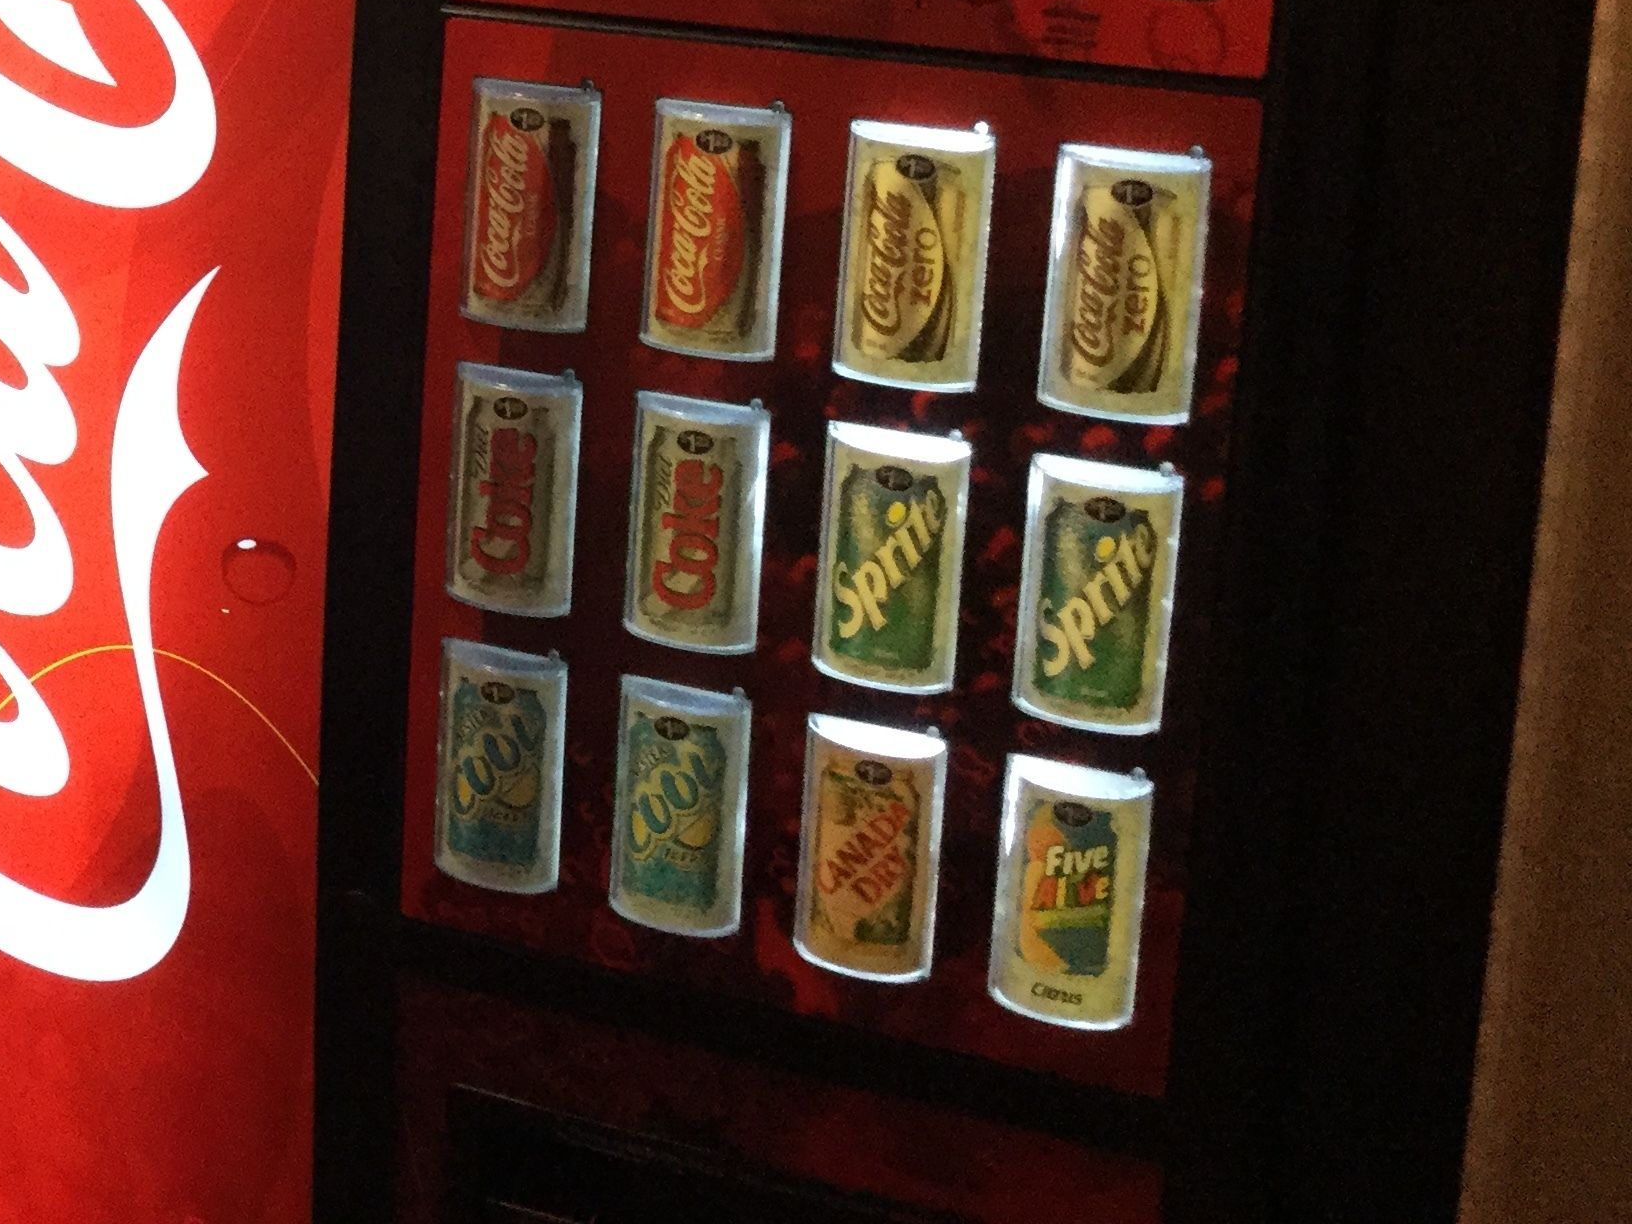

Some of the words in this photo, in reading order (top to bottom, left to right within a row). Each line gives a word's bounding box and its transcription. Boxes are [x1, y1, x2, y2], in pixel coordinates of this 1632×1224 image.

[480, 127, 530, 288] Coca-Cola
[665, 152, 716, 314] Coca-Cola
[862, 182, 914, 337] Coca-Cola
[910, 226, 938, 307] zero
[1073, 212, 1125, 367] Coca-Cola
[1120, 253, 1153, 337] zero
[470, 428, 538, 575] Coke
[652, 458, 724, 610] Coke
[833, 489, 946, 639] Sprite
[1038, 522, 1156, 678] Sprite
[818, 801, 910, 896] CANADA
[850, 845, 908, 907] DRY
